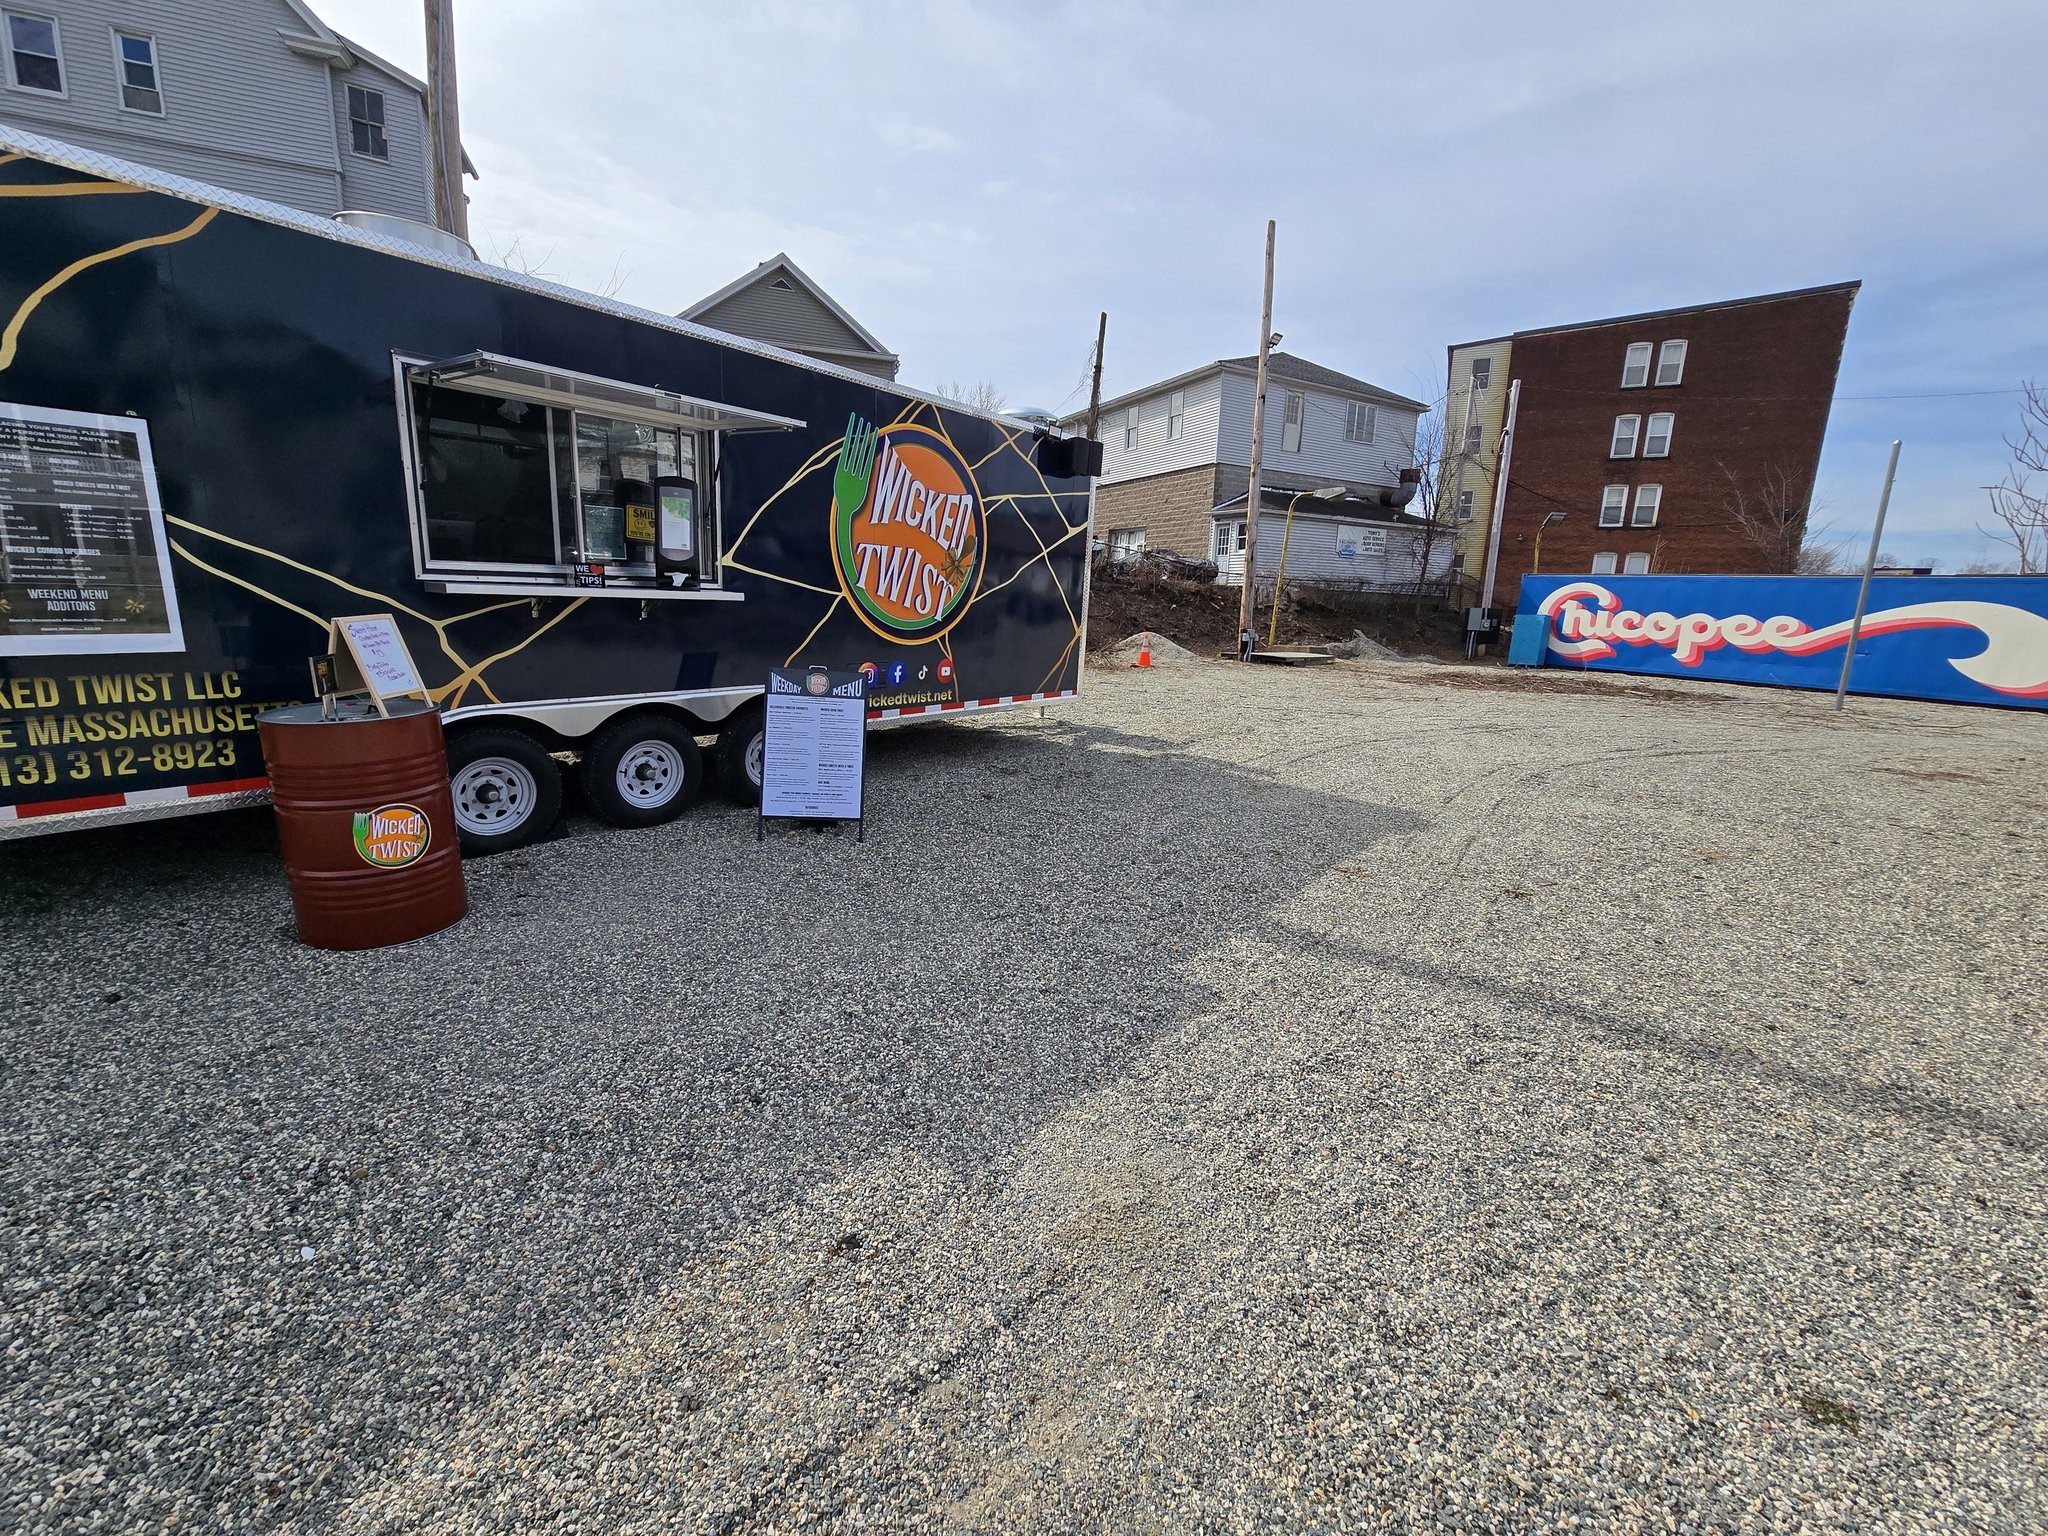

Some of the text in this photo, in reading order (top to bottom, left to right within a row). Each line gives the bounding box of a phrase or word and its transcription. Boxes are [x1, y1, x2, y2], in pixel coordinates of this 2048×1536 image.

[0, 421, 26, 429] ACING
[870, 432, 973, 558] WICKED
[633, 508, 656, 521] SMIL
[6, 545, 101, 556] WICKED COMBO UPGRADES
[575, 564, 590, 572] WE
[580, 576, 602, 584] TIPS!
[856, 542, 955, 623] TWIST
[27, 588, 108, 600] WEEKEND MENU
[48, 600, 96, 612] ADDITONS
[1537, 582, 1815, 666] Chicopee
[68, 672, 174, 706] TWIST
[184, 670, 242, 701] LLC
[771, 672, 802, 694] WEEKDAY
[832, 678, 863, 698] MENU
[869, 688, 952, 708] ickedtwist.net
[27, 700, 302, 747] MASSACHUSET
[66, 738, 236, 780] 312-8923
[372, 813, 420, 840] WICKED
[368, 840, 420, 859] TWIST
